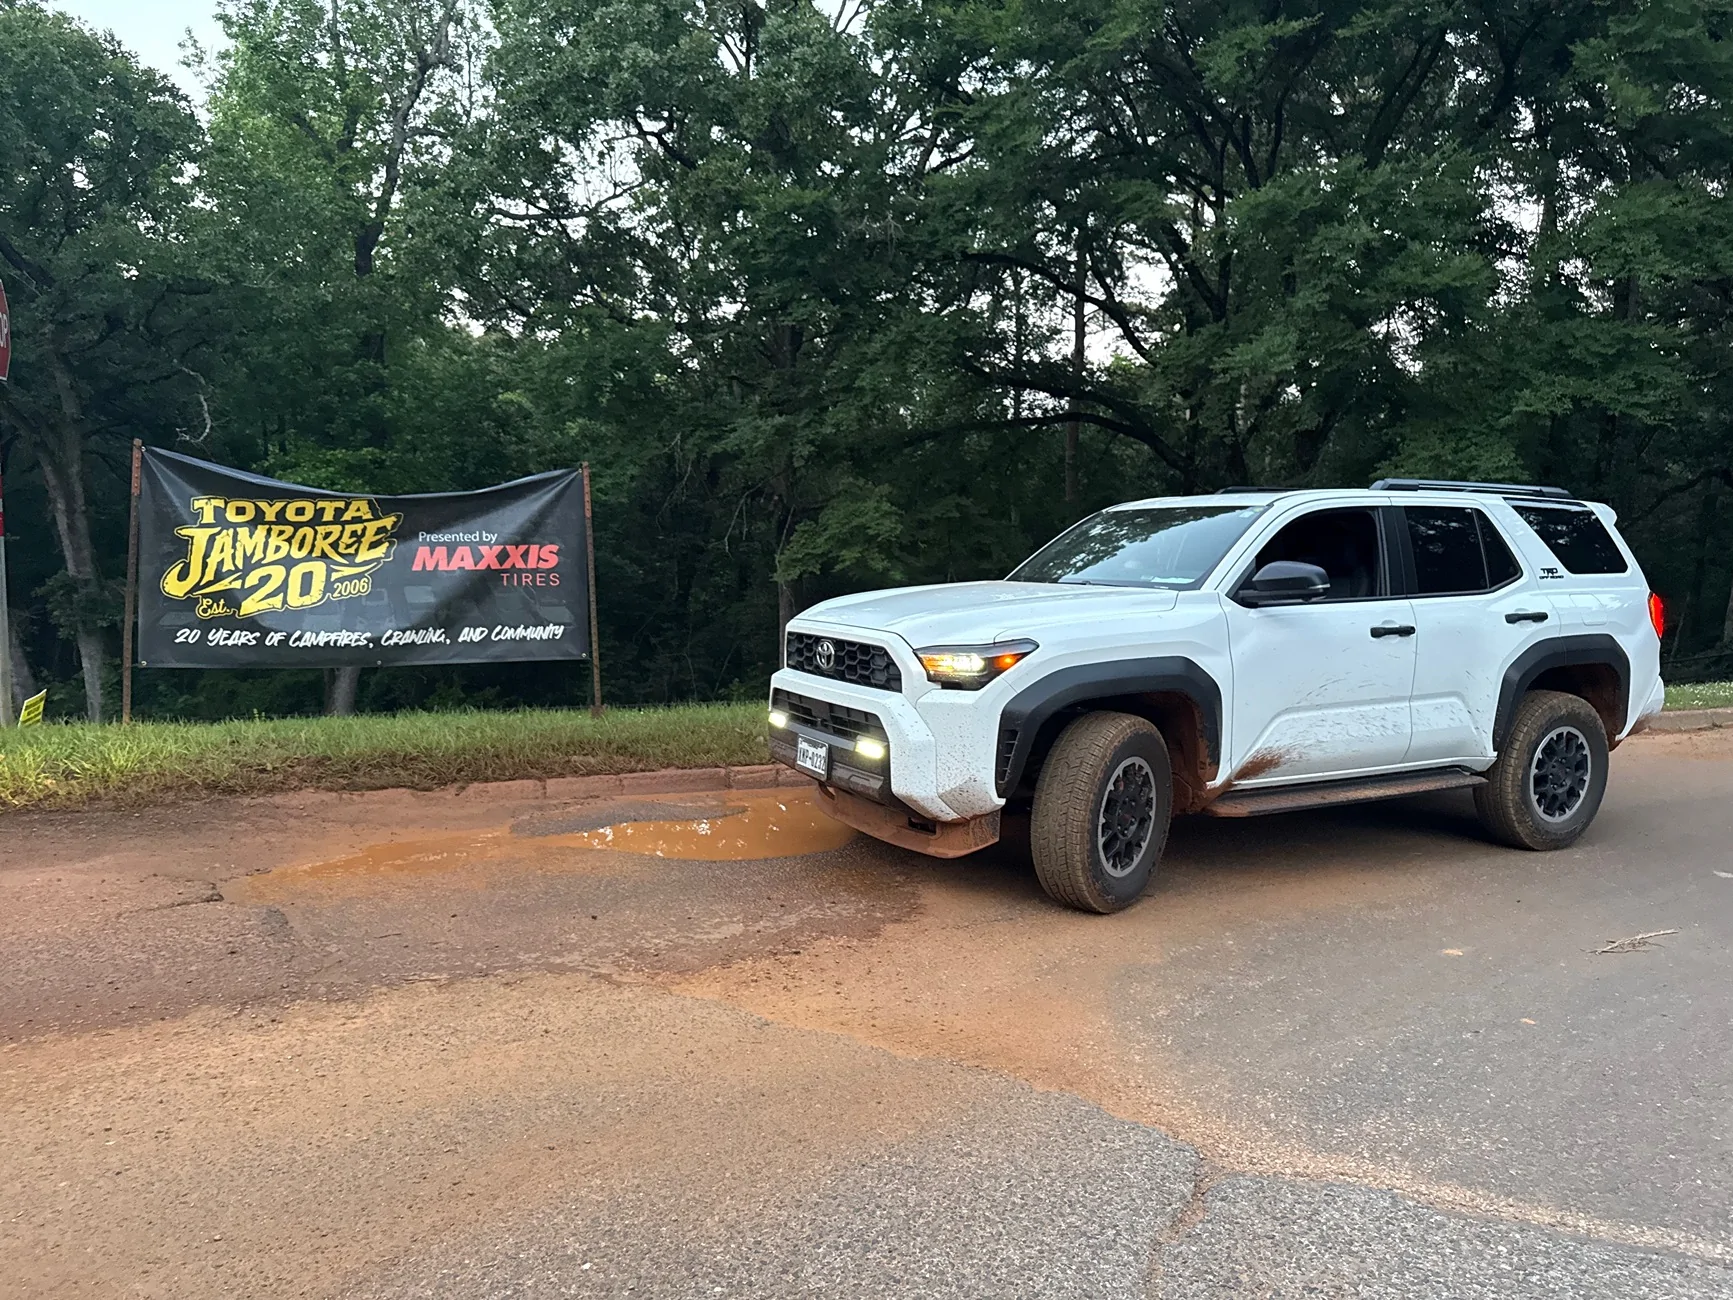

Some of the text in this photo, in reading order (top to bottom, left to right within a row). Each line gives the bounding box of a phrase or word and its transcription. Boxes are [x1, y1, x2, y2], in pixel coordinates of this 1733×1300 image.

[194, 498, 374, 524] TOYOTA
[418, 531, 498, 544] Presented by
[162, 515, 398, 597] JAMBOREE
[412, 544, 560, 571] MAXXIS
[239, 561, 327, 616] 20
[501, 573, 560, 586] TIRES
[198, 579, 369, 617] Est. 2006
[174, 623, 565, 649] 20 YEARS OF CAMPFIRES, CRAWLING, AND COMMUNITY
